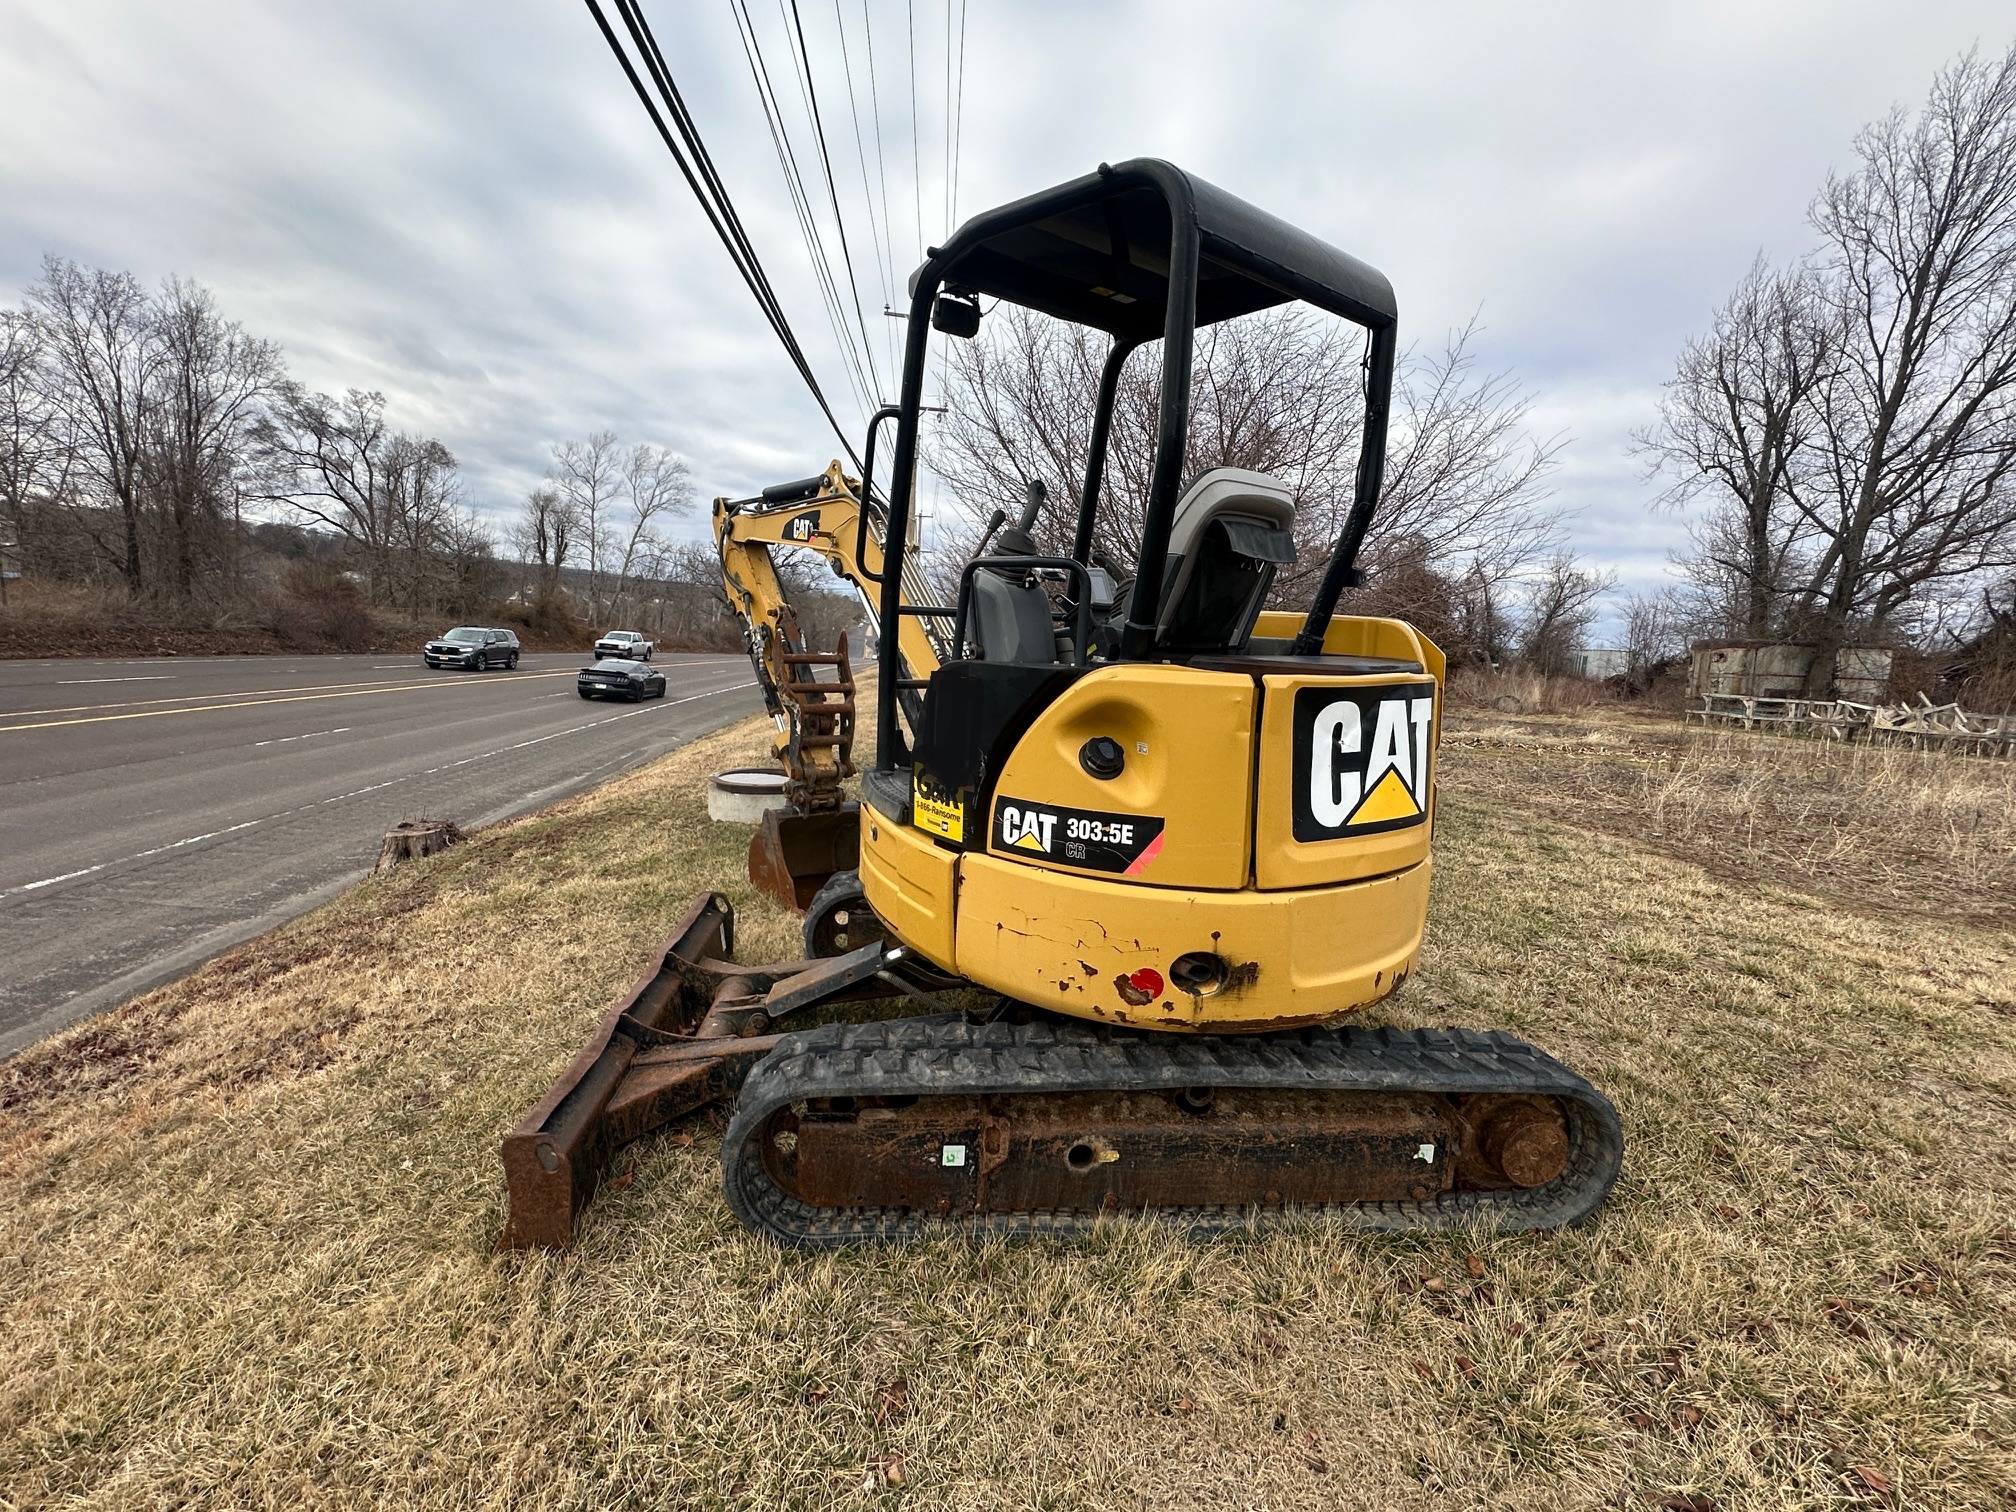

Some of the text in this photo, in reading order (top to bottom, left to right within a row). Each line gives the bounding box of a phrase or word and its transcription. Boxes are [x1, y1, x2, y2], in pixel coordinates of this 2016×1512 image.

[793, 518, 810, 540] CAT
[1310, 697, 1432, 828] CAT
[1002, 806, 1134, 853] CAT 303.5E
[1065, 841, 1086, 860] CR
